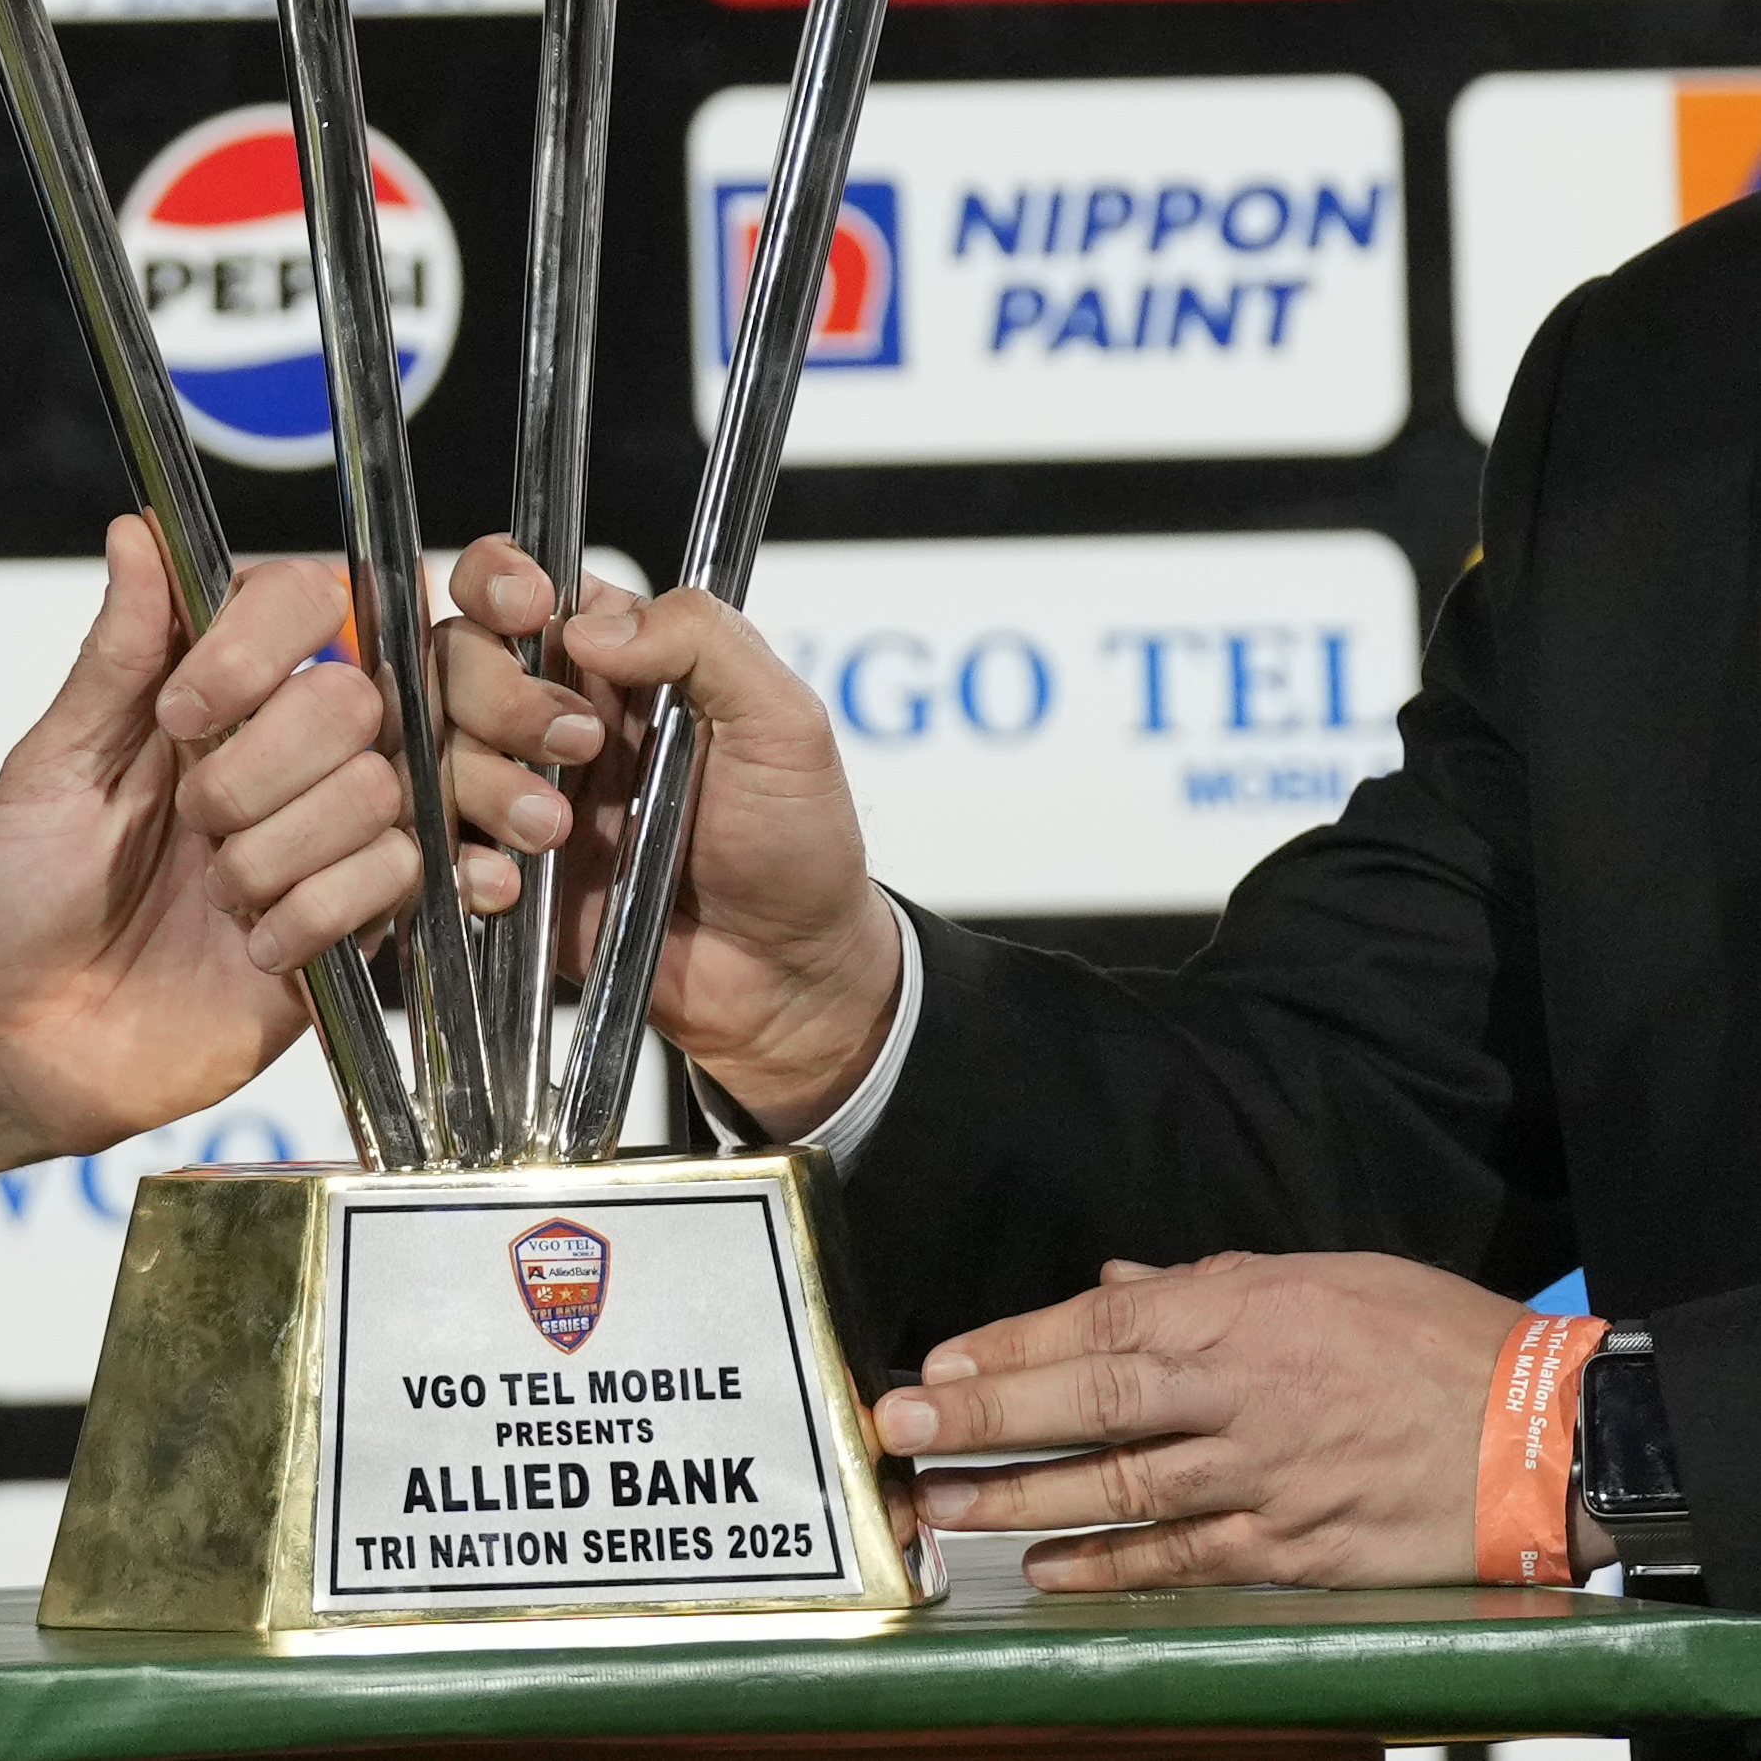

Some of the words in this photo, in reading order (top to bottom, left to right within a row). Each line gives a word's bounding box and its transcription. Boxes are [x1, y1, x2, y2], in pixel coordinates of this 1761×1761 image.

[954, 179, 1388, 259] NIPPON
[144, 253, 424, 313] PEPI
[991, 281, 1312, 353] PAINT
[795, 629, 1056, 743] GO
[1101, 628, 1398, 736] TEL
[1183, 754, 1403, 807] MOBIL
[529, 1240, 560, 1251] VGO
[564, 1239, 595, 1250] TEL
[541, 1317, 590, 1334] SERIES
[1519, 1319, 1550, 1352] FINAL
[402, 1374, 487, 1409] VGO
[500, 1372, 575, 1406] TEL
[589, 1366, 742, 1404] MOBILE
[1505, 1354, 1535, 1413] MATCH
[1533, 1330, 1569, 1412] Tri-Nation
[496, 1418, 655, 1447] PRESENTS
[1525, 1414, 1548, 1470] Series
[403, 1463, 591, 1514] ALLIED
[611, 1457, 759, 1507] BANK
[356, 1536, 416, 1571] TRI
[430, 1530, 569, 1569] NATION
[583, 1527, 714, 1563] SERIES
[728, 1523, 813, 1559] 2025
[1520, 1550, 1539, 1578] Box
